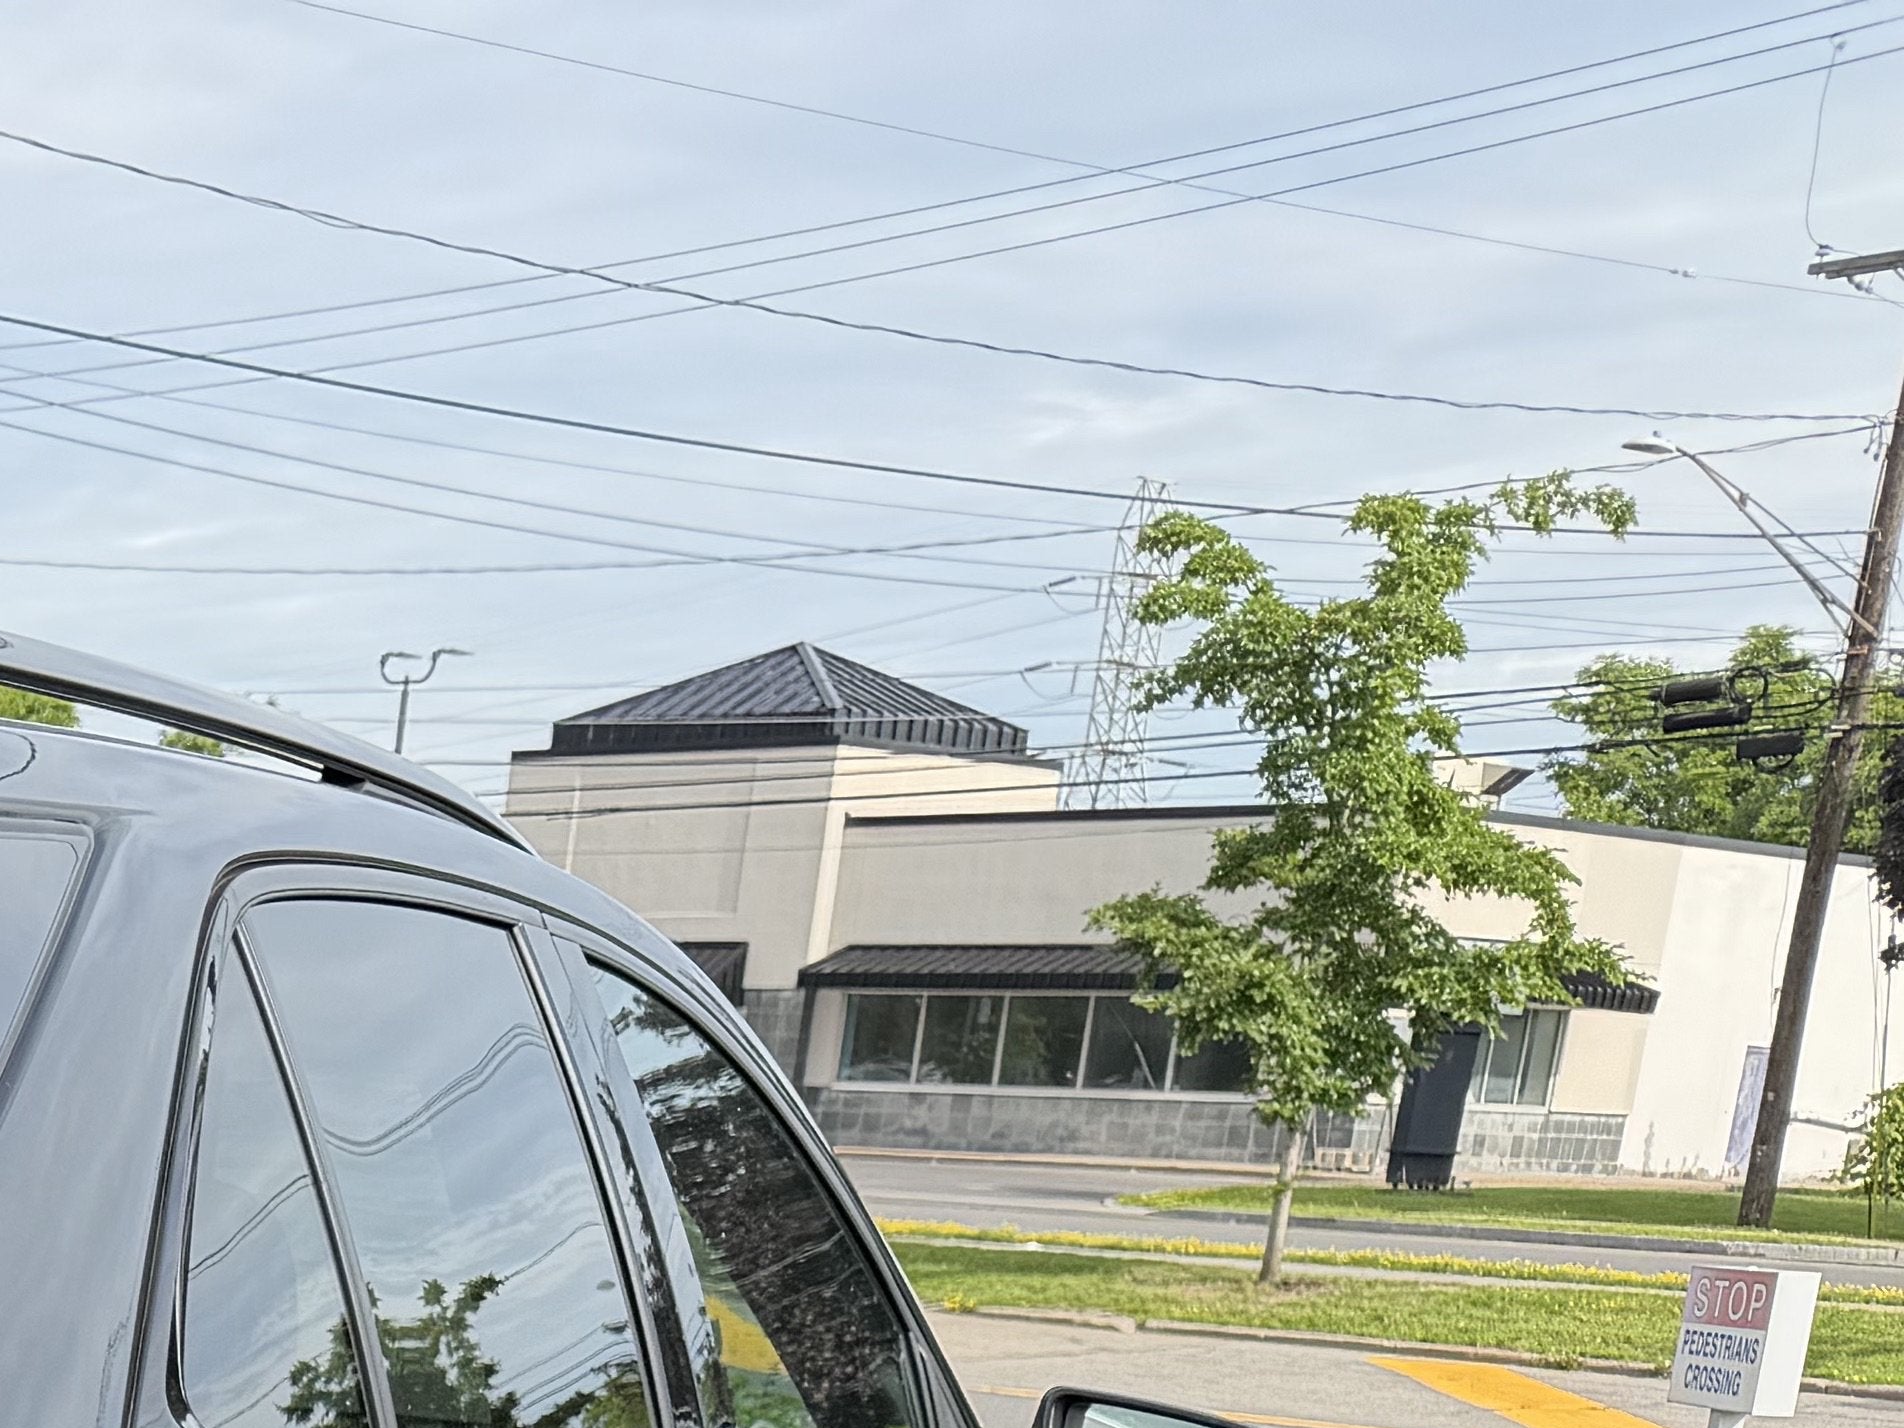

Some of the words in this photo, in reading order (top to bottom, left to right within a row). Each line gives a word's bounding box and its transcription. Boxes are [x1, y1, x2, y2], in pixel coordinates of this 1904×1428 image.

[1694, 1278, 1767, 1321] STOP
[1681, 1329, 1760, 1364] PEDESTRIANS
[1684, 1363, 1742, 1396] CROSSING
